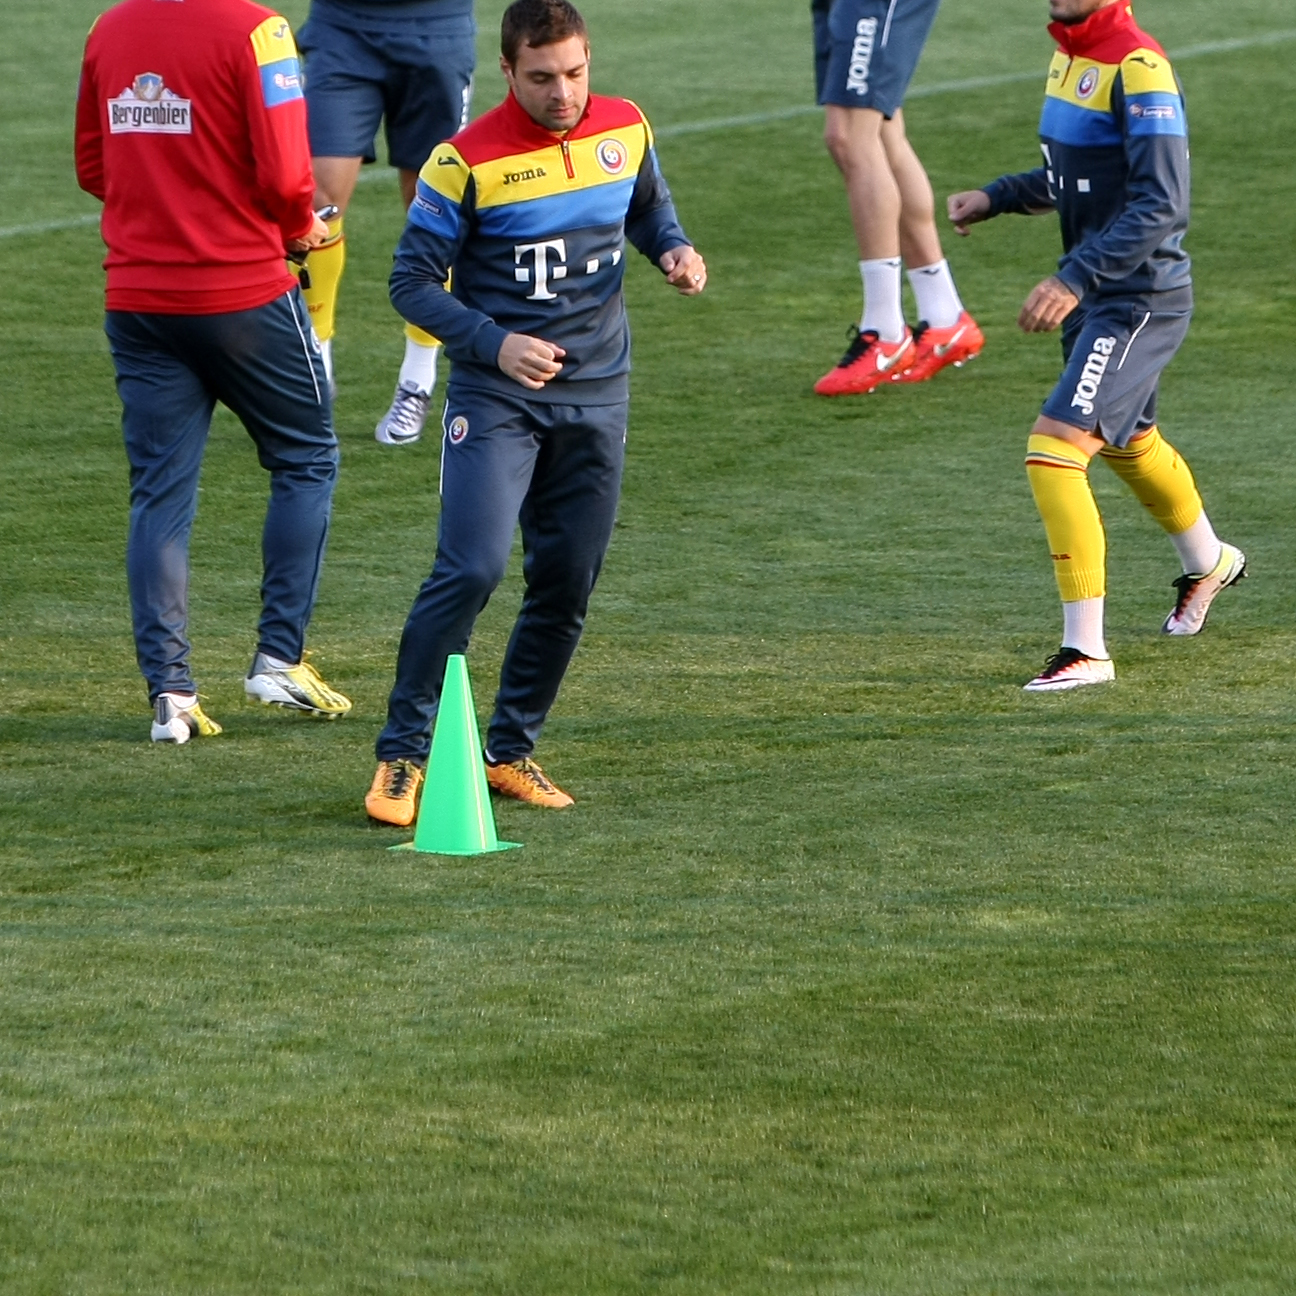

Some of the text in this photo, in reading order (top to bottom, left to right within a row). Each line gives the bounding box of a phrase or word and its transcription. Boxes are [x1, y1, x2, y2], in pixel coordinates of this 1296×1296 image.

[846, 17, 878, 96] Joma
[112, 104, 188, 127] Bergenbier
[503, 167, 546, 185] Joma
[514, 238, 567, 300] T
[1071, 335, 1117, 415] Joma
